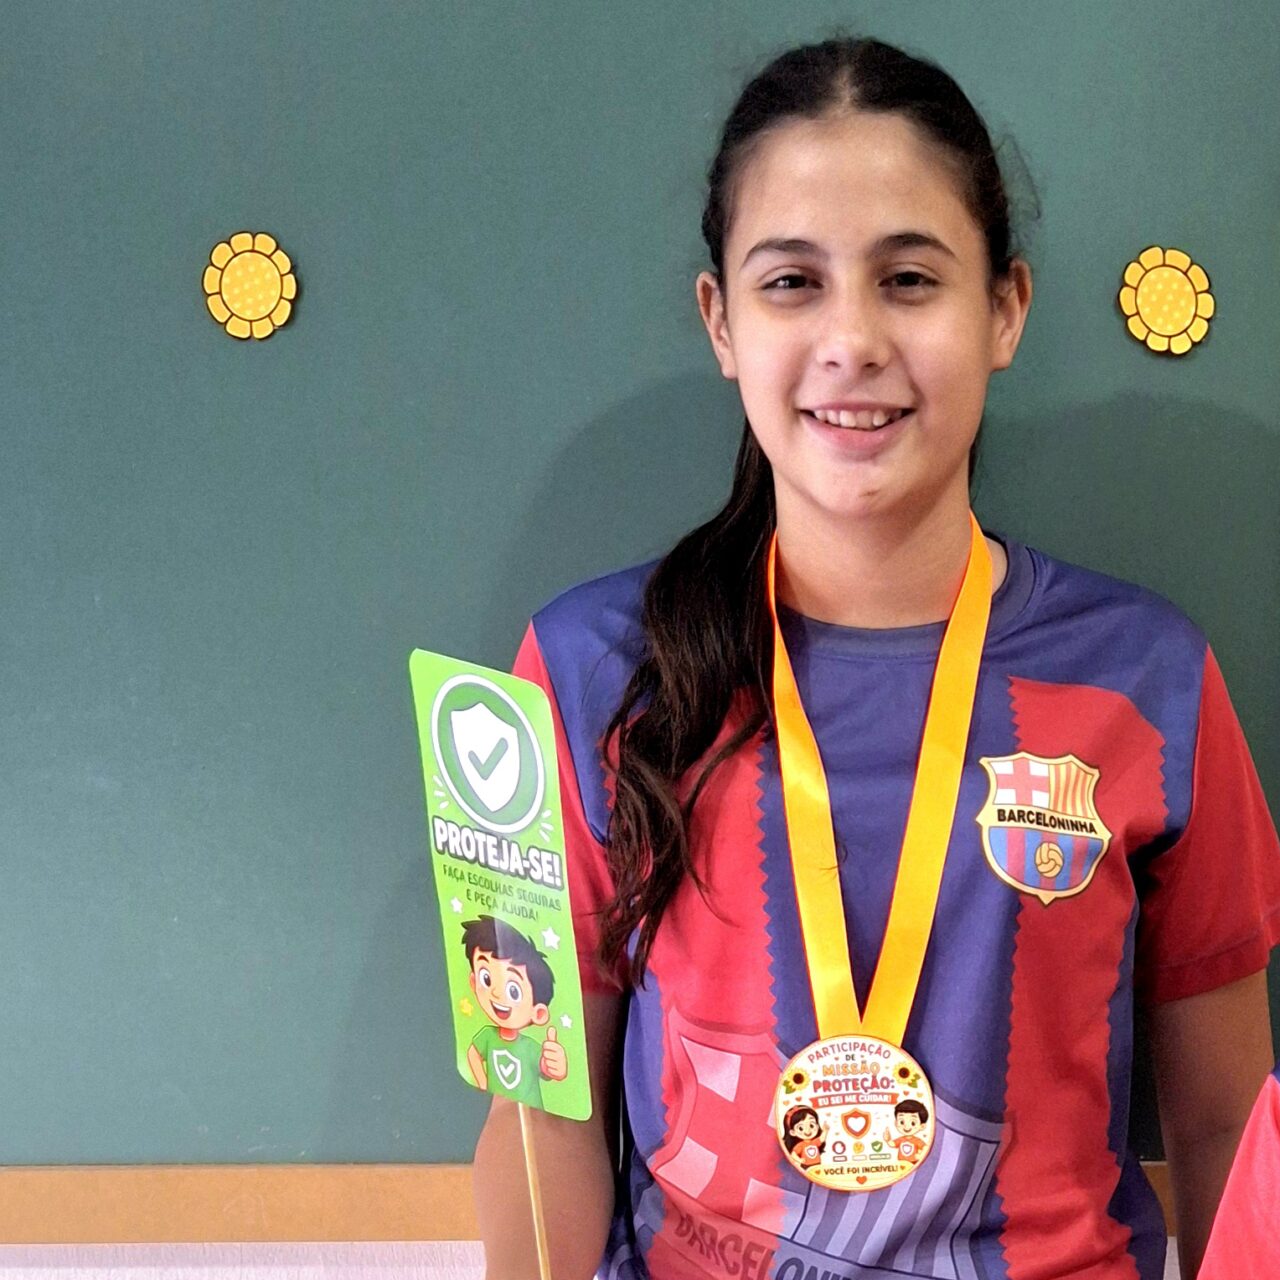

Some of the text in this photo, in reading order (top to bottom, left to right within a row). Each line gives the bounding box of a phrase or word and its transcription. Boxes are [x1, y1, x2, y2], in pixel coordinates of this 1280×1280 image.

[997, 809, 1097, 834] BARCELONINHA
[433, 816, 564, 891] PROTEJA-SE!
[443, 864, 561, 911] FAÇA ESCOLHAS SEGURAS
[466, 889, 538, 920] E PEÇA AJUDA!
